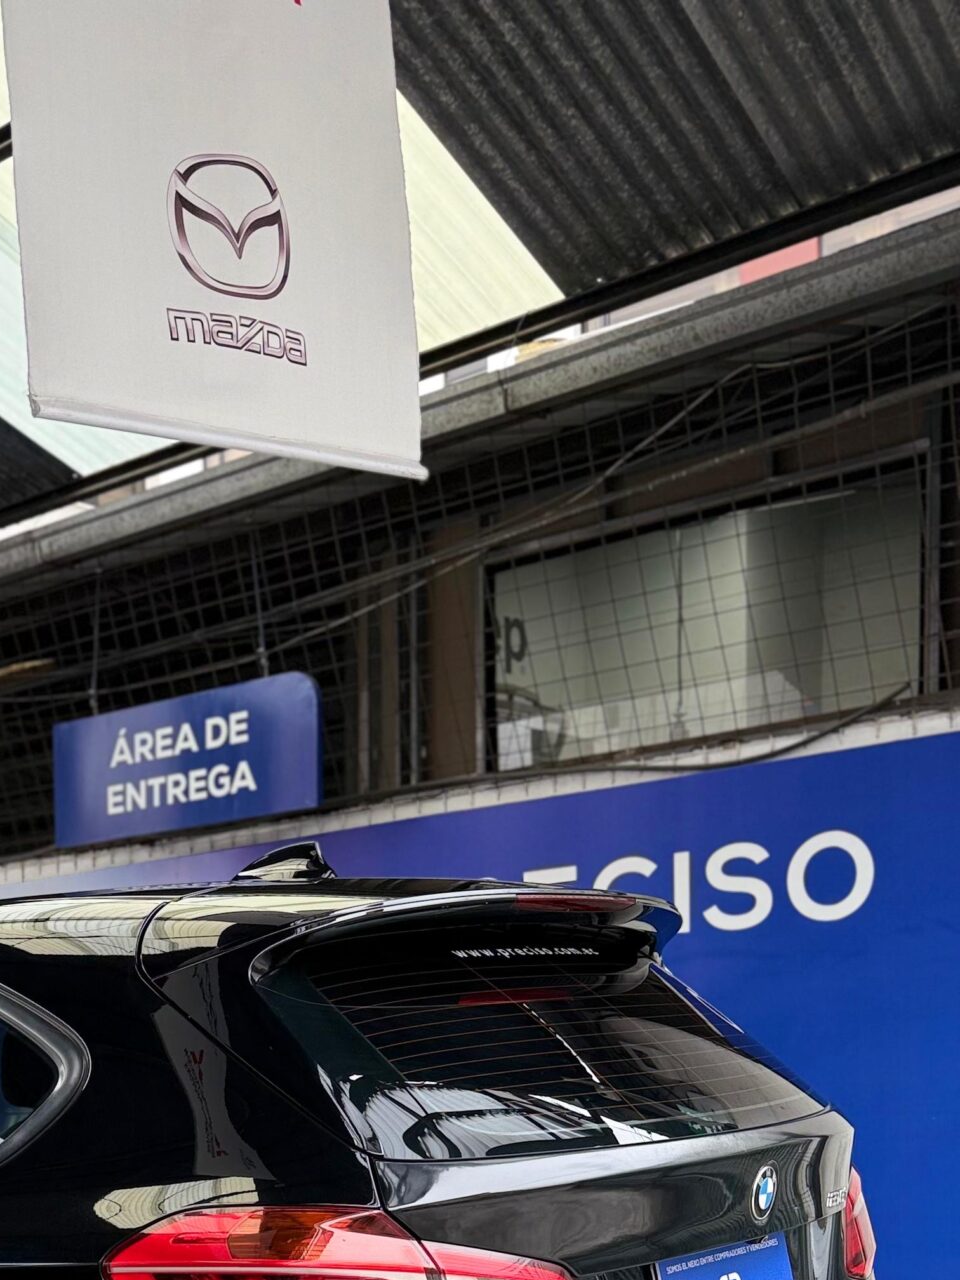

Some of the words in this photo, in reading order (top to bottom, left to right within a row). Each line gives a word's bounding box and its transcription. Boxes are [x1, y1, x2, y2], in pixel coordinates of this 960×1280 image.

[110, 727, 200, 769] ÁREA
[205, 710, 250, 750] DE
[106, 760, 258, 816] ENTREGA
[714, 1246, 747, 1261] COMPRADORES
